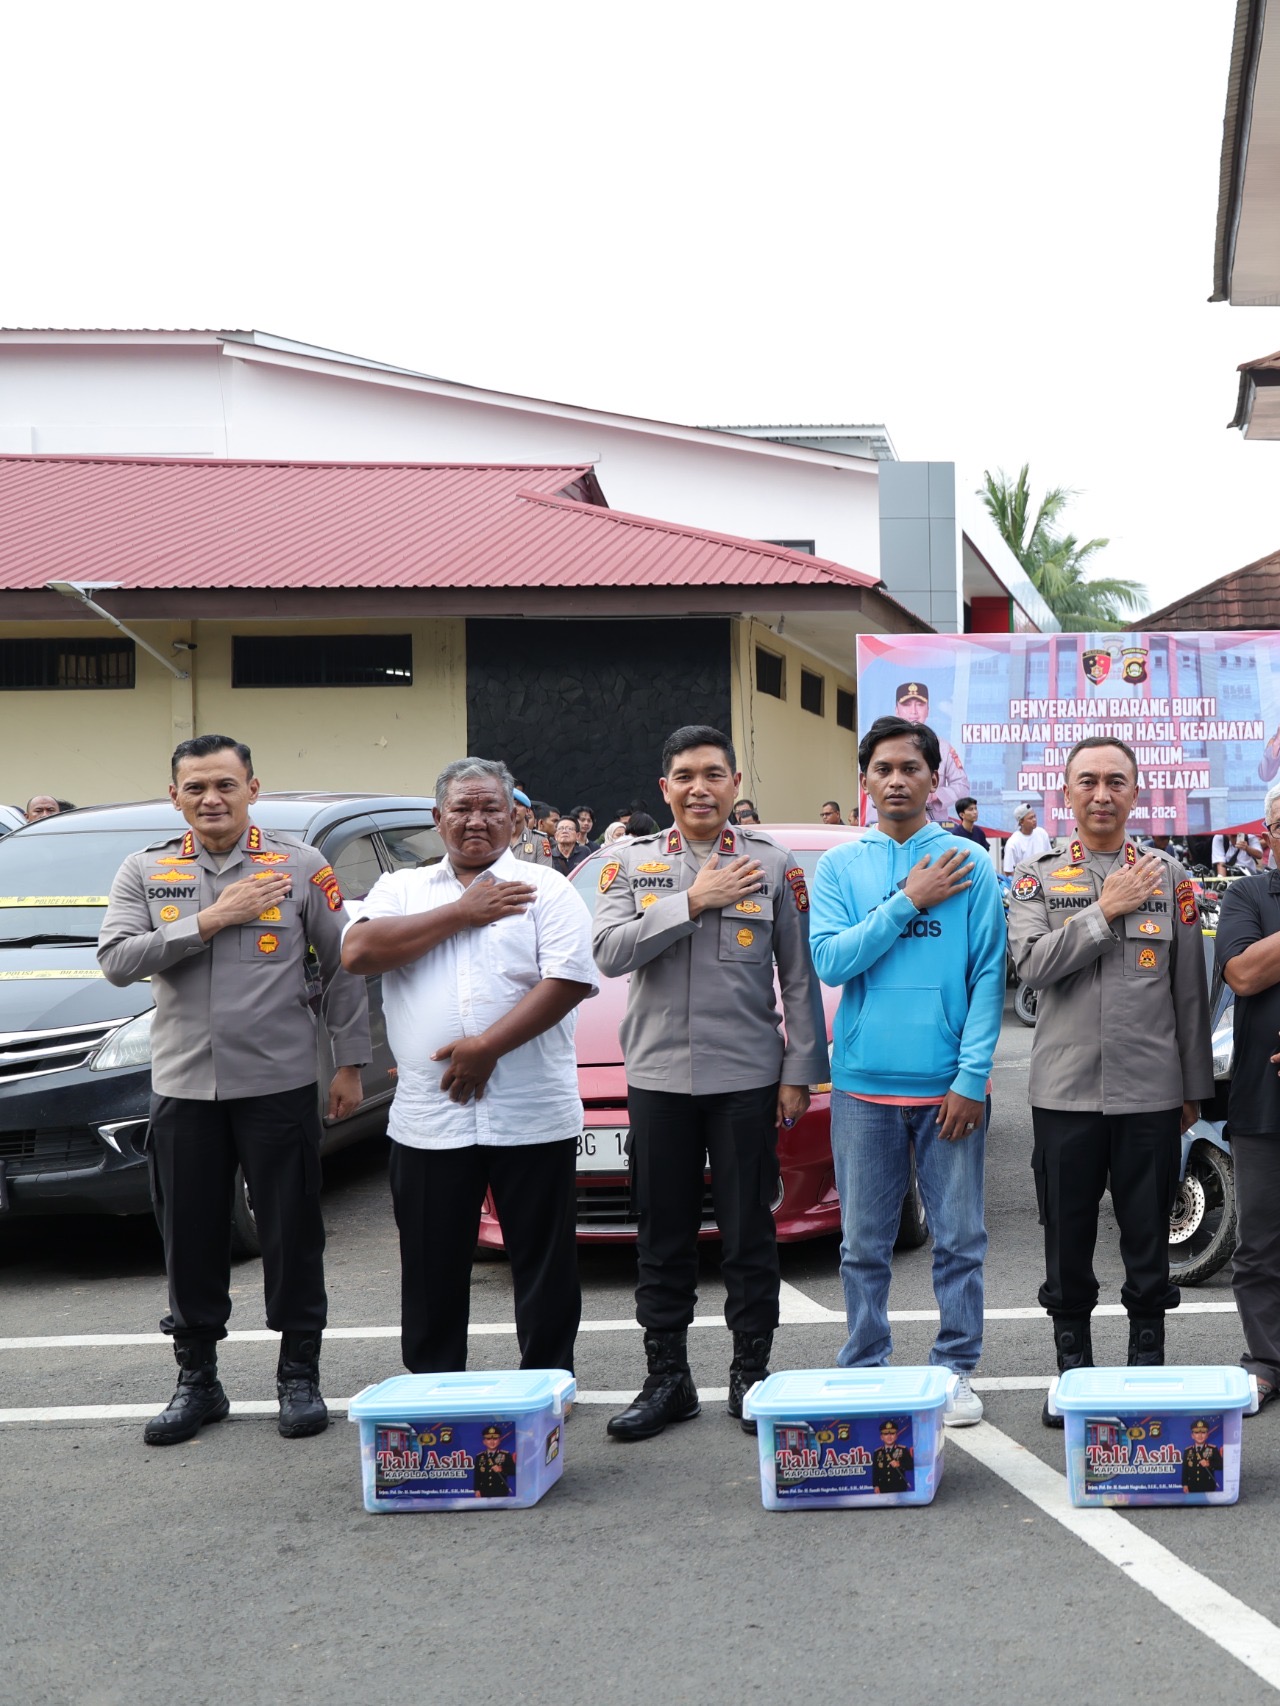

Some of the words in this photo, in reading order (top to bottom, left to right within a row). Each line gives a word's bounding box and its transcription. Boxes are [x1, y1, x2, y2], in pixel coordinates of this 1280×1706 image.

[1010, 699, 1108, 719] PENYERAHAN
[1109, 698, 1169, 718] BARANG
[1172, 698, 1216, 717] BUKTI
[962, 724, 1051, 743] KENDARAAN
[1053, 723, 1134, 742] BERMOTOR
[1136, 722, 1178, 742] HASIL
[1180, 721, 1264, 741] KEJAHATAN
[1044, 748, 1060, 767] DI
[1018, 772, 1065, 791] POLDA
[1149, 770, 1210, 790] SELATAN
[1129, 807, 1151, 819] PRIL
[1152, 806, 1177, 819] 2026
[633, 877, 673, 889] RONY.S
[148, 886, 196, 899] SONNY
[1050, 897, 1092, 909] SHANDI
[1138, 901, 1168, 913] OLRI
[576, 1133, 596, 1156] BG
[377, 1451, 420, 1471] Tali
[424, 1449, 476, 1470] Asih
[776, 1450, 819, 1469] Tali
[824, 1446, 873, 1467] Asih
[1086, 1445, 1128, 1465] Tali
[1134, 1443, 1183, 1465] Asih
[384, 1471, 428, 1479] KAPOLDA
[430, 1470, 467, 1478] SUMSEL
[784, 1469, 826, 1478] KAPOLDA
[828, 1467, 866, 1476] SUMSEL
[1093, 1466, 1136, 1475] KAPOLDA
[1138, 1465, 1175, 1474] SUMSEL
